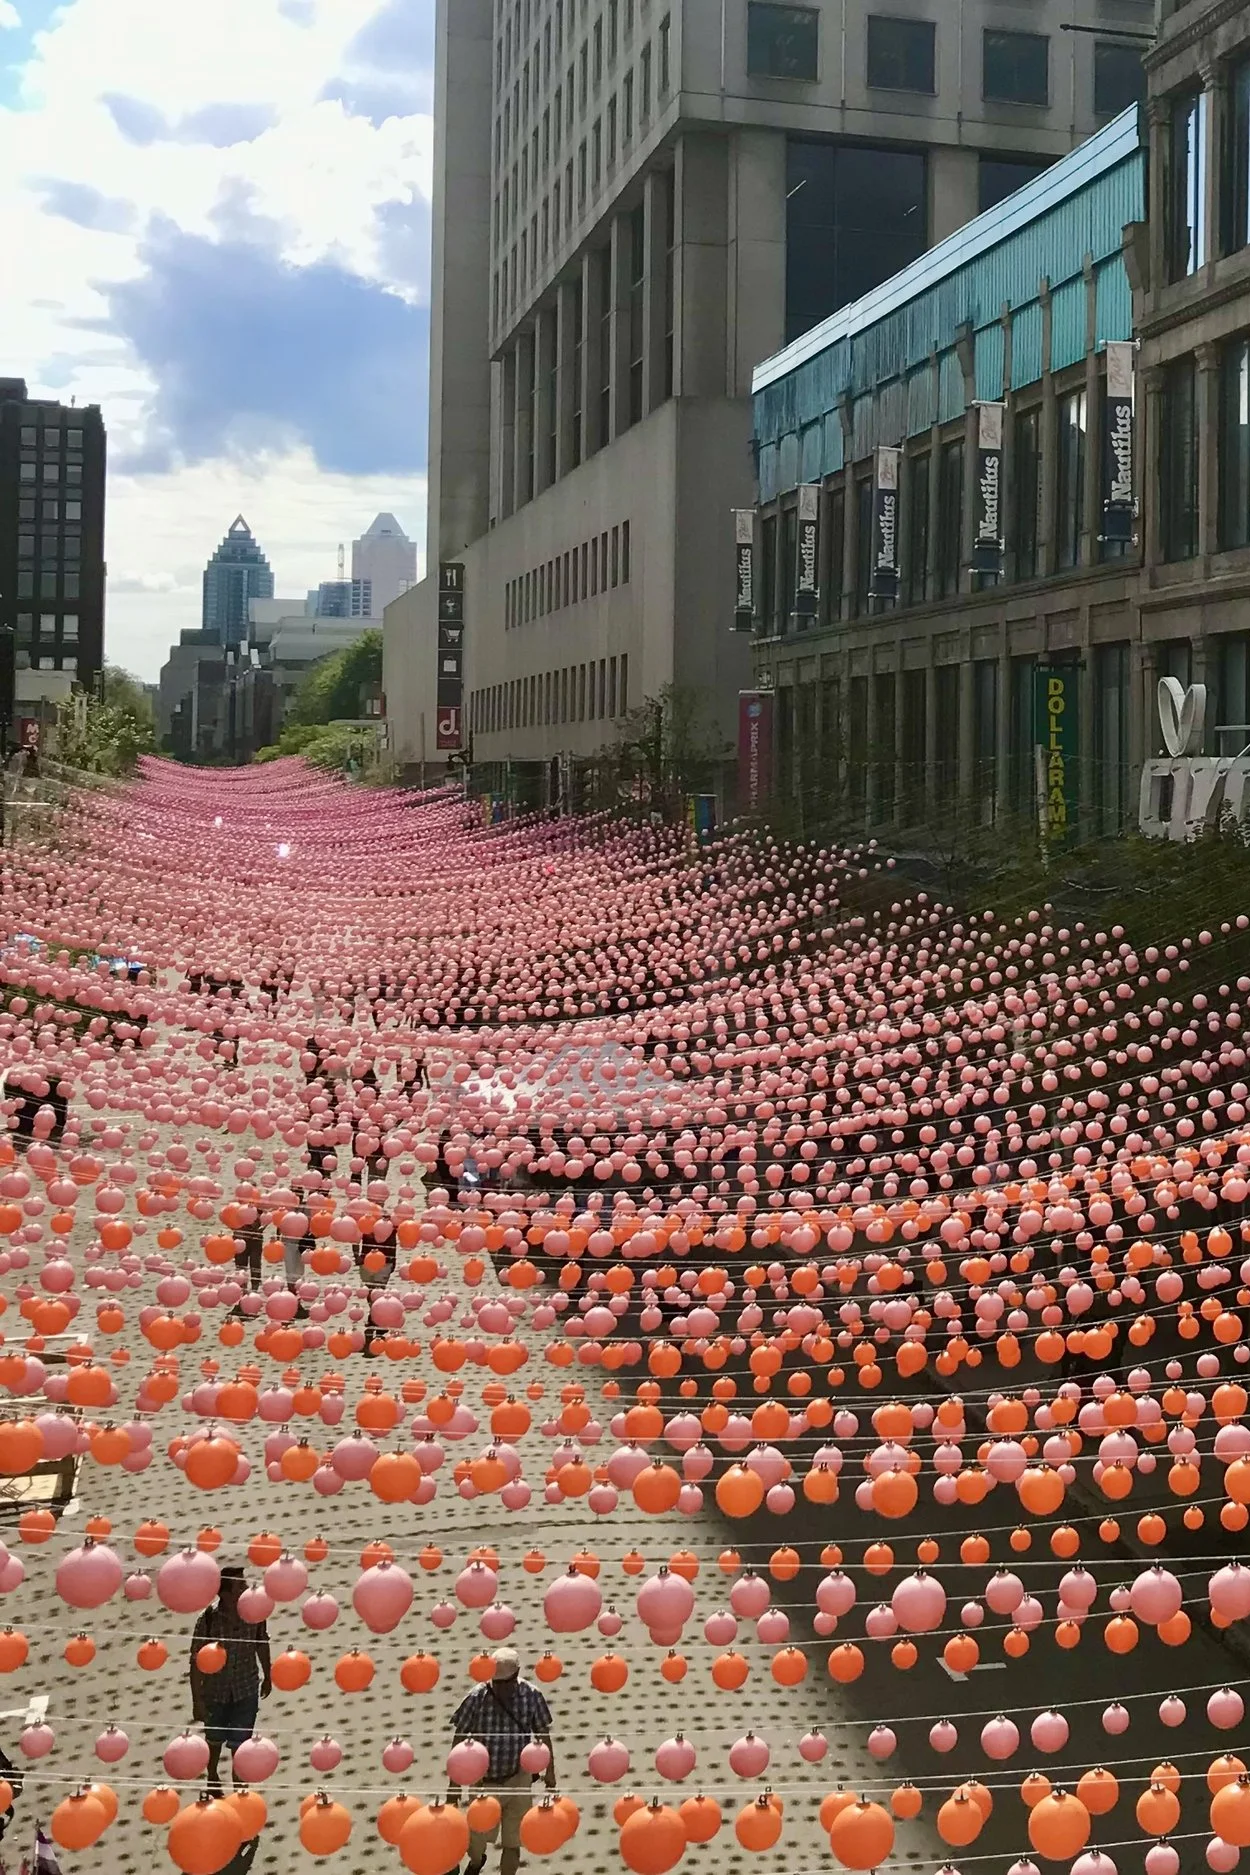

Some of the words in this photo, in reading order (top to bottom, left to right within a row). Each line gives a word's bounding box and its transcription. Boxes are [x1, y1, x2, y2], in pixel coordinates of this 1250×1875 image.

[1111, 405, 1132, 501] Nautilus
[878, 495, 895, 568] Nautilus
[979, 456, 999, 539] Nautilus
[738, 548, 752, 607] Nautilus
[799, 525, 815, 591] Nautilus
[1047, 678, 1067, 841] DOLLARAMA
